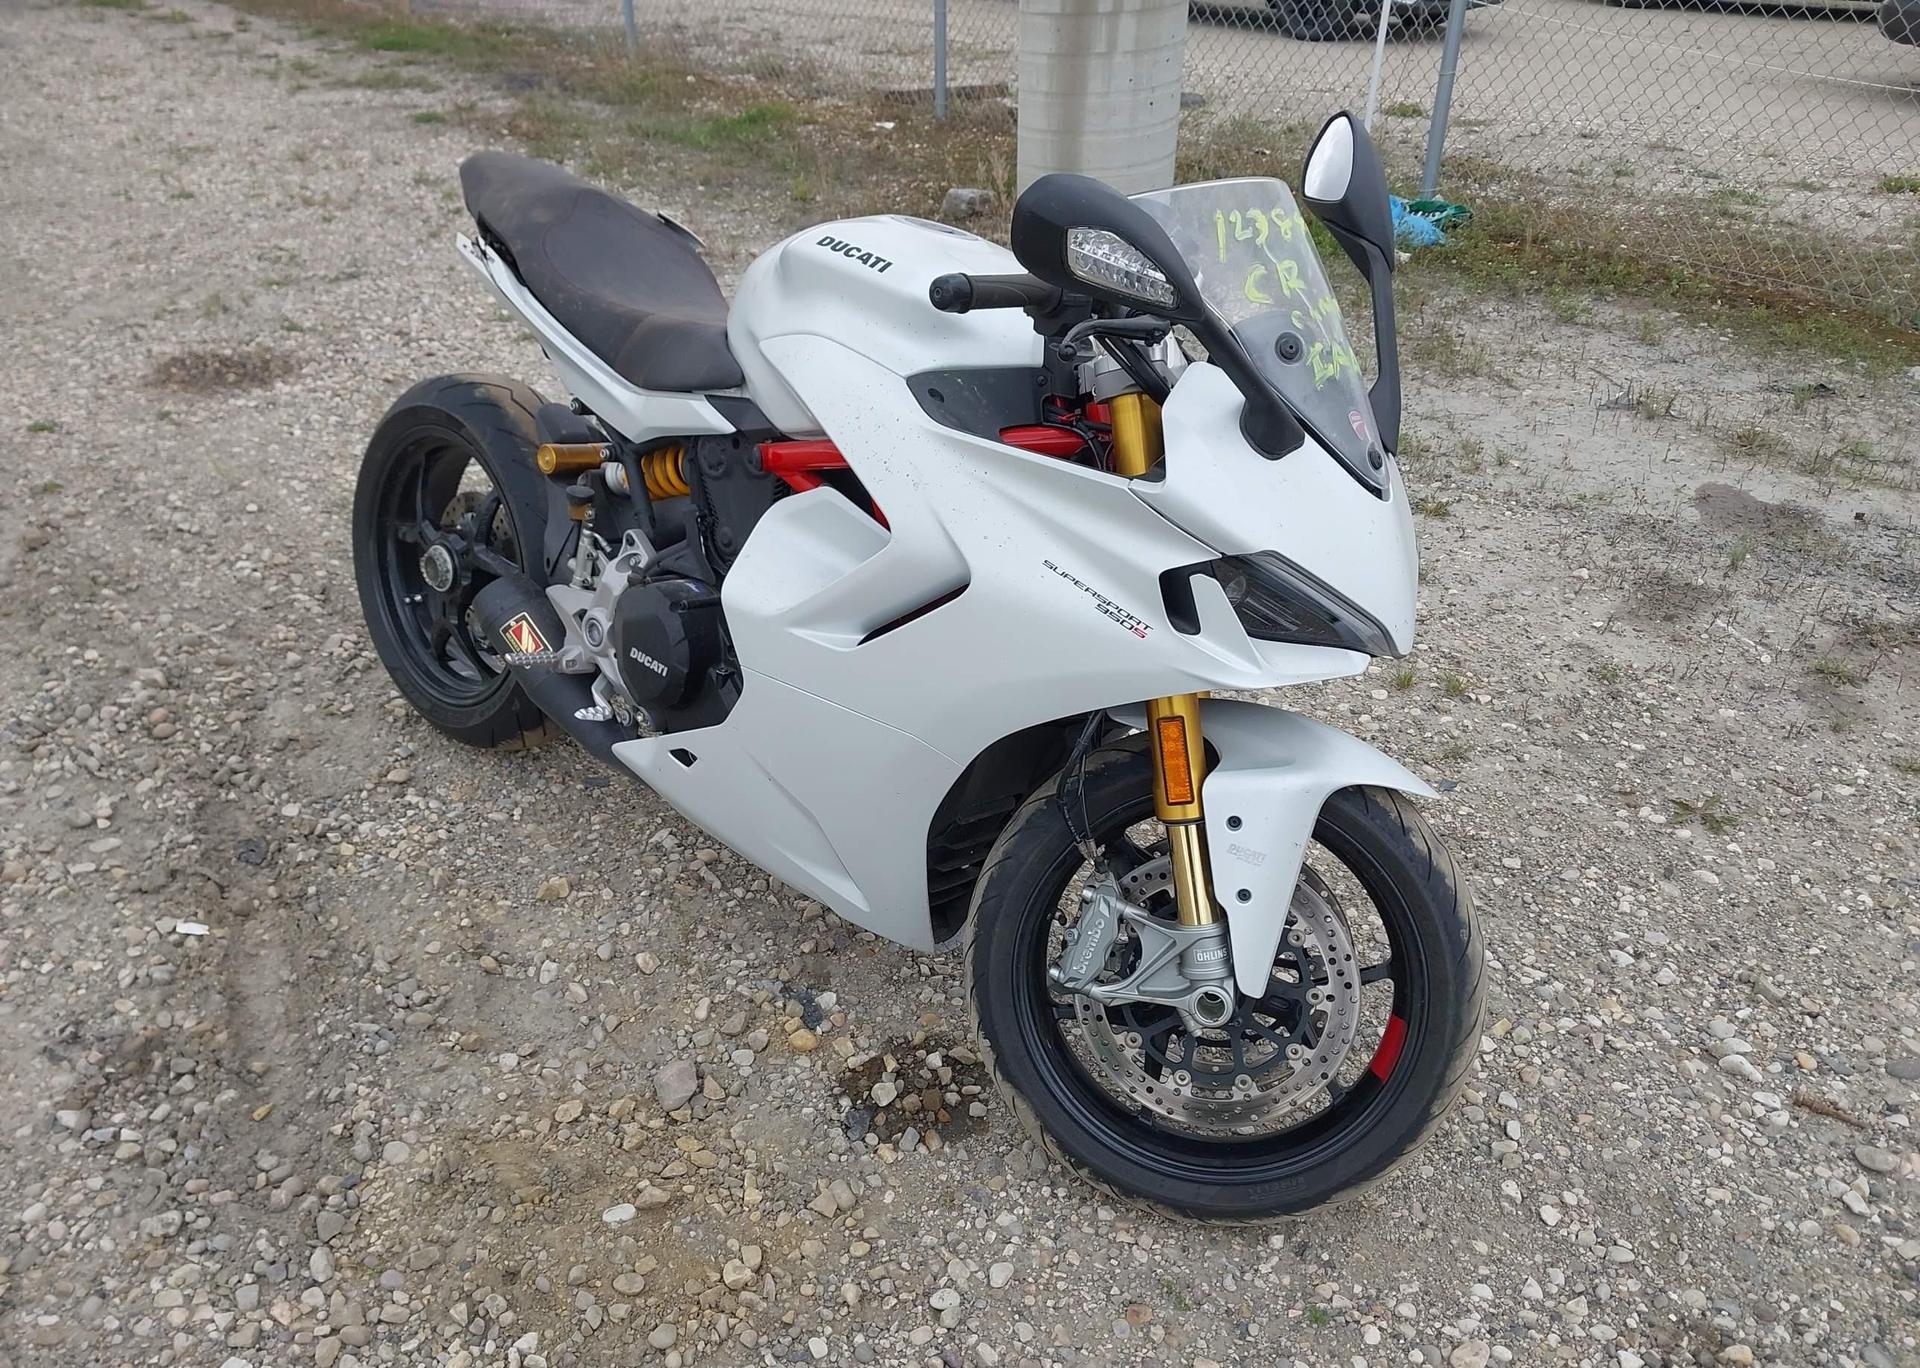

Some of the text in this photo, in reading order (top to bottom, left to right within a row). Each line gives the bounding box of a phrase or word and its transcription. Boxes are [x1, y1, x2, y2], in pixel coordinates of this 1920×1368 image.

[816, 235, 894, 274] DUCATI
[1041, 559, 1154, 631] SUPERSPORT
[1094, 603, 1148, 639] 950S
[629, 646, 669, 678] DUCATI
[1072, 918, 1106, 975] brembo
